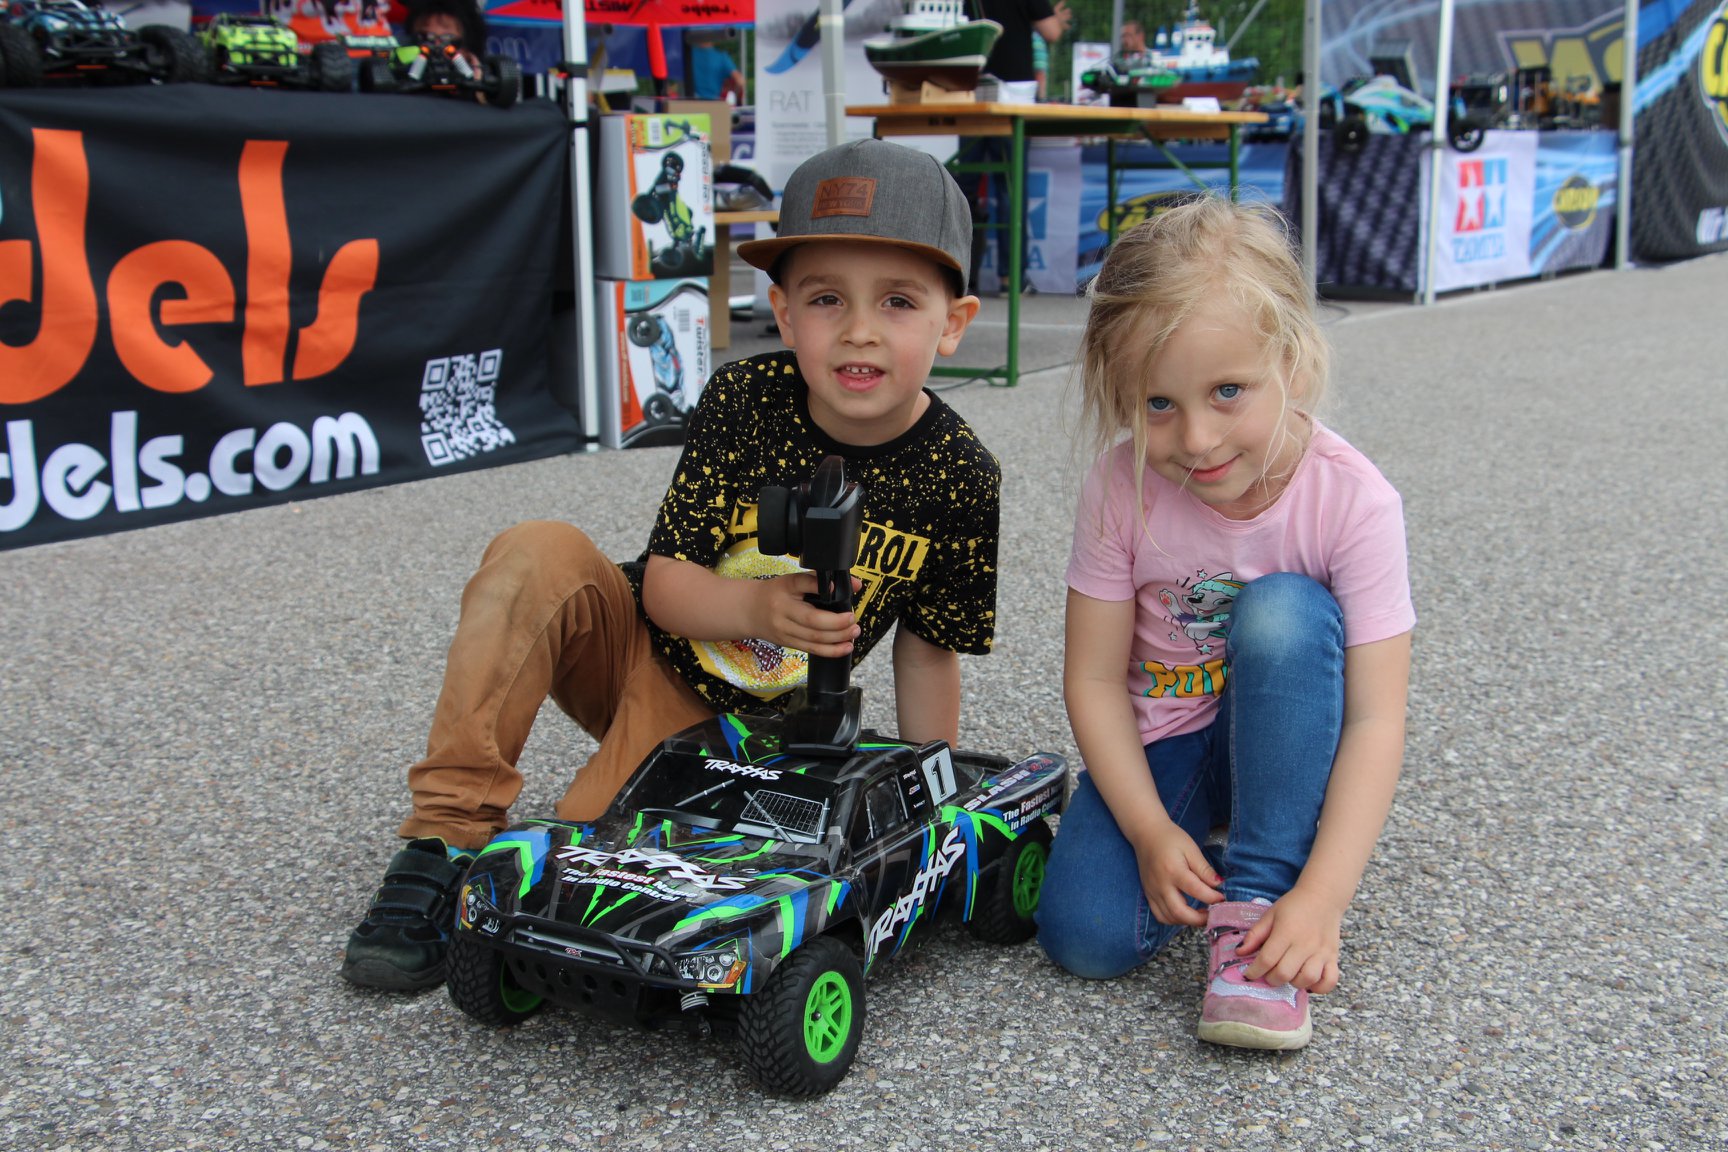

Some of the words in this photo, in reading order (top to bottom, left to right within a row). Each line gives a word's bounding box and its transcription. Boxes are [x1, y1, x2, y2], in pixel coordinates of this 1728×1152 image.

[769, 89, 815, 112] RAT
[820, 183, 868, 197] NY74
[704, 759, 783, 781] TRAXXAS
[930, 756, 948, 799] 1
[963, 769, 1031, 811] SLASH
[1003, 808, 1020, 822] The
[1021, 788, 1050, 814] Fastest
[1020, 808, 1041, 827] Radio
[555, 845, 756, 890] TRAXXAS
[621, 882, 681, 902] Control
[867, 826, 966, 963] TRAXXAS
